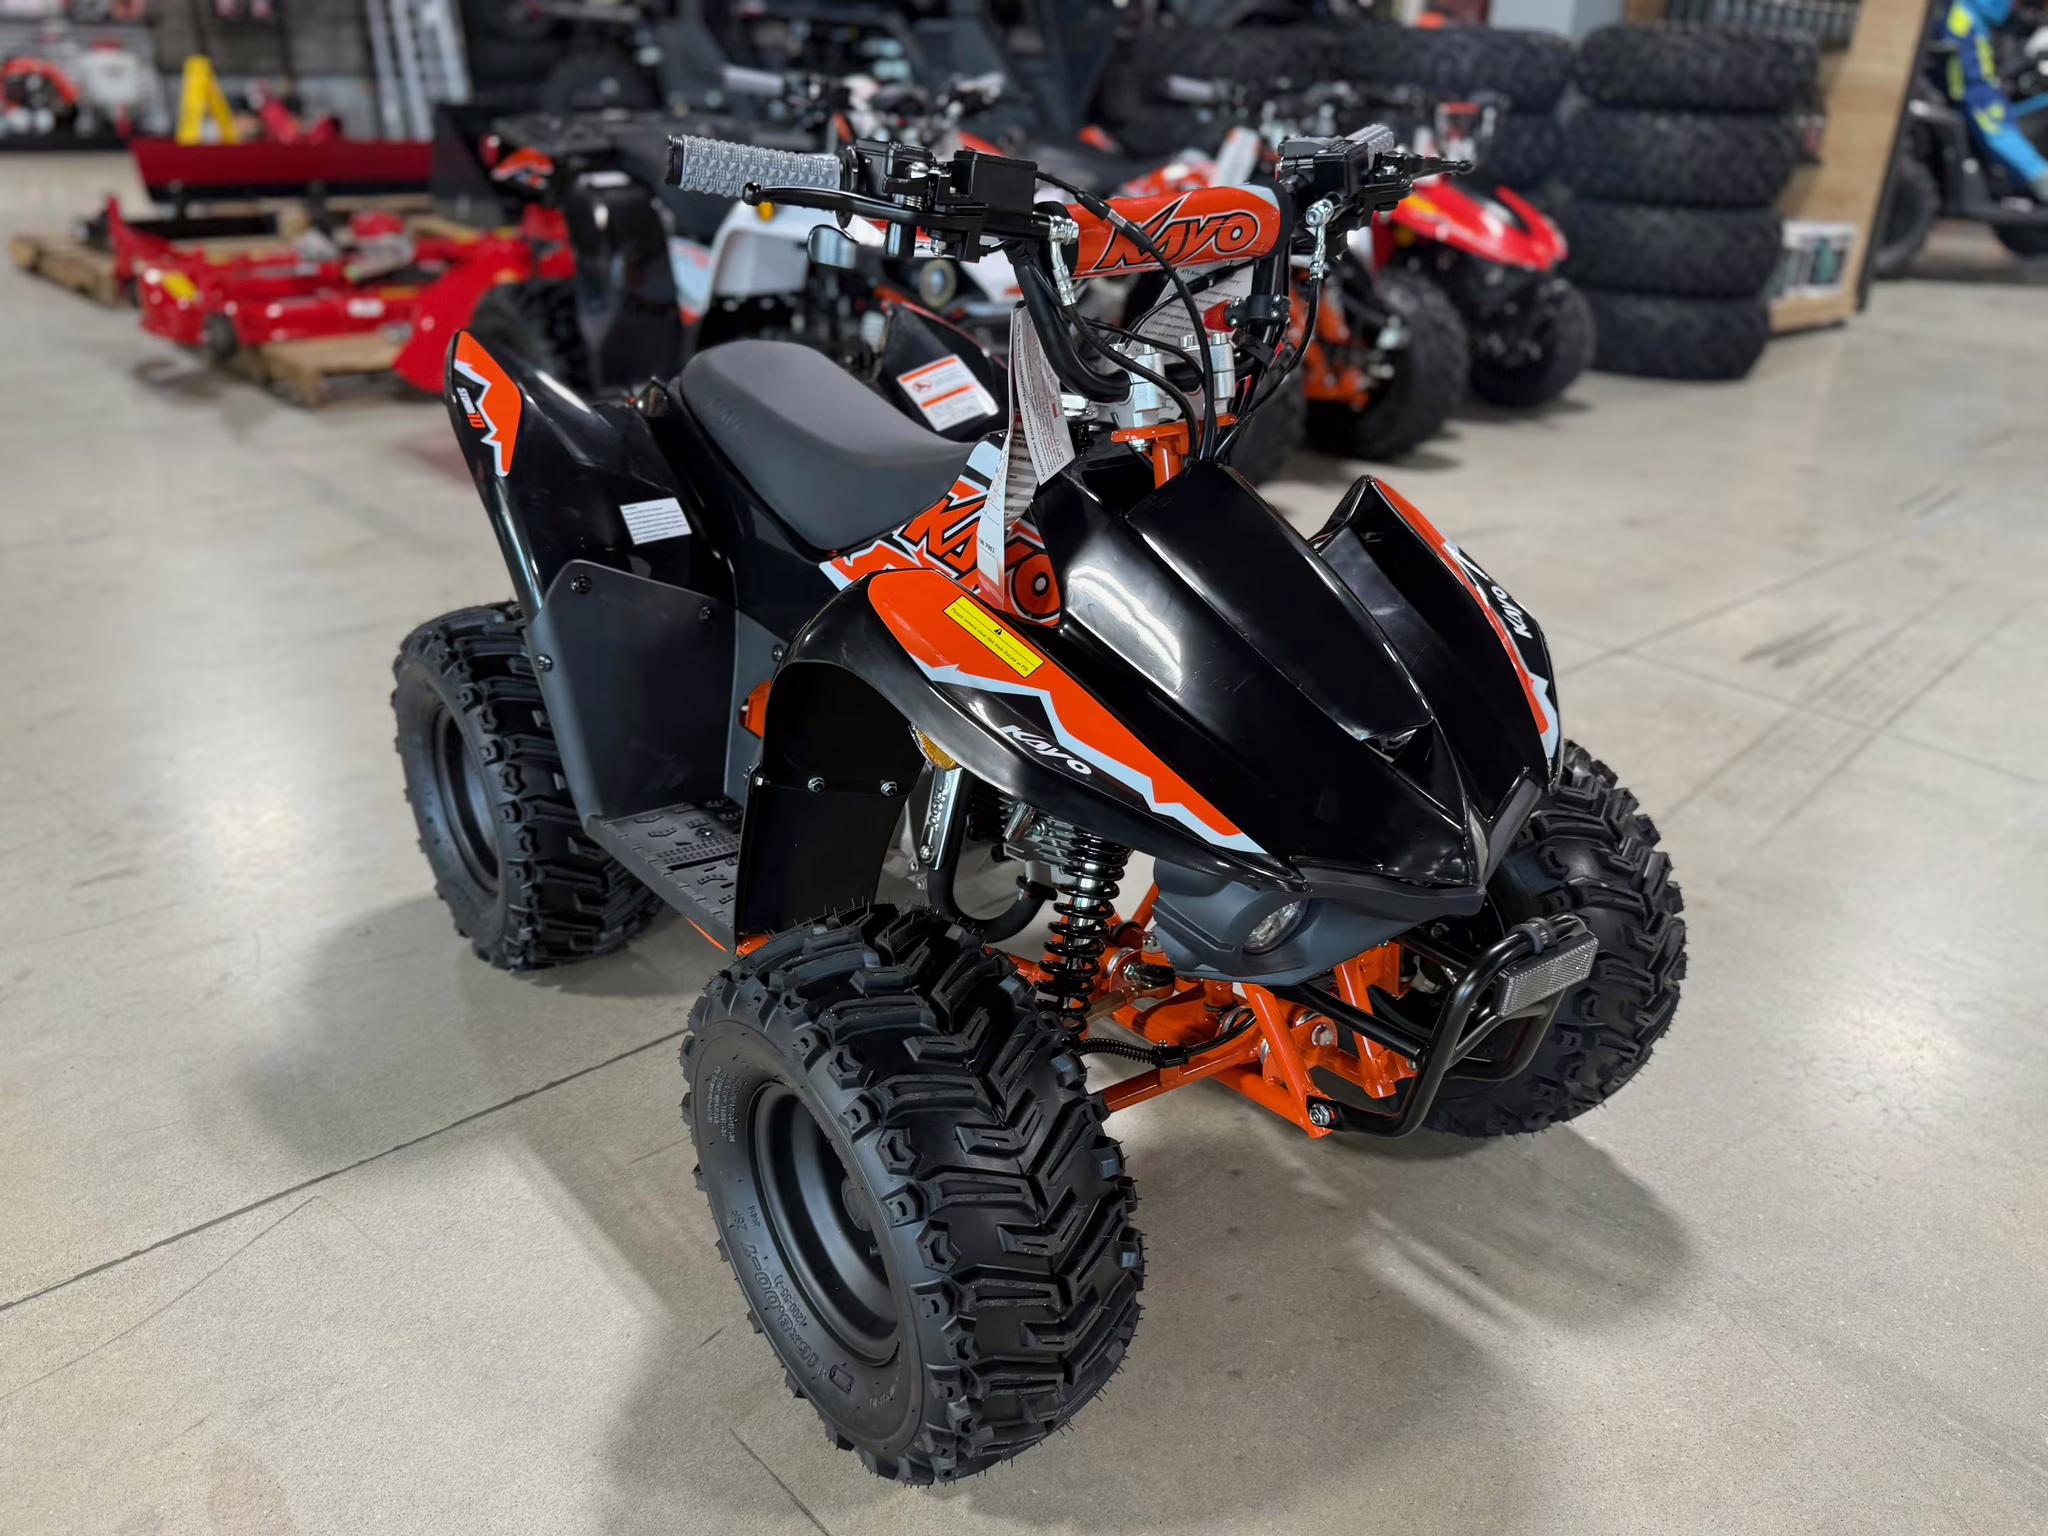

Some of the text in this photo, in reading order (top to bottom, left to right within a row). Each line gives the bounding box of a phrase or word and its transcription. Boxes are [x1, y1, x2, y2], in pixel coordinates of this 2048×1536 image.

[1091, 190, 1261, 271] KAYO
[1491, 585, 1533, 639] KAYO
[1000, 724, 1092, 775] KAYO
